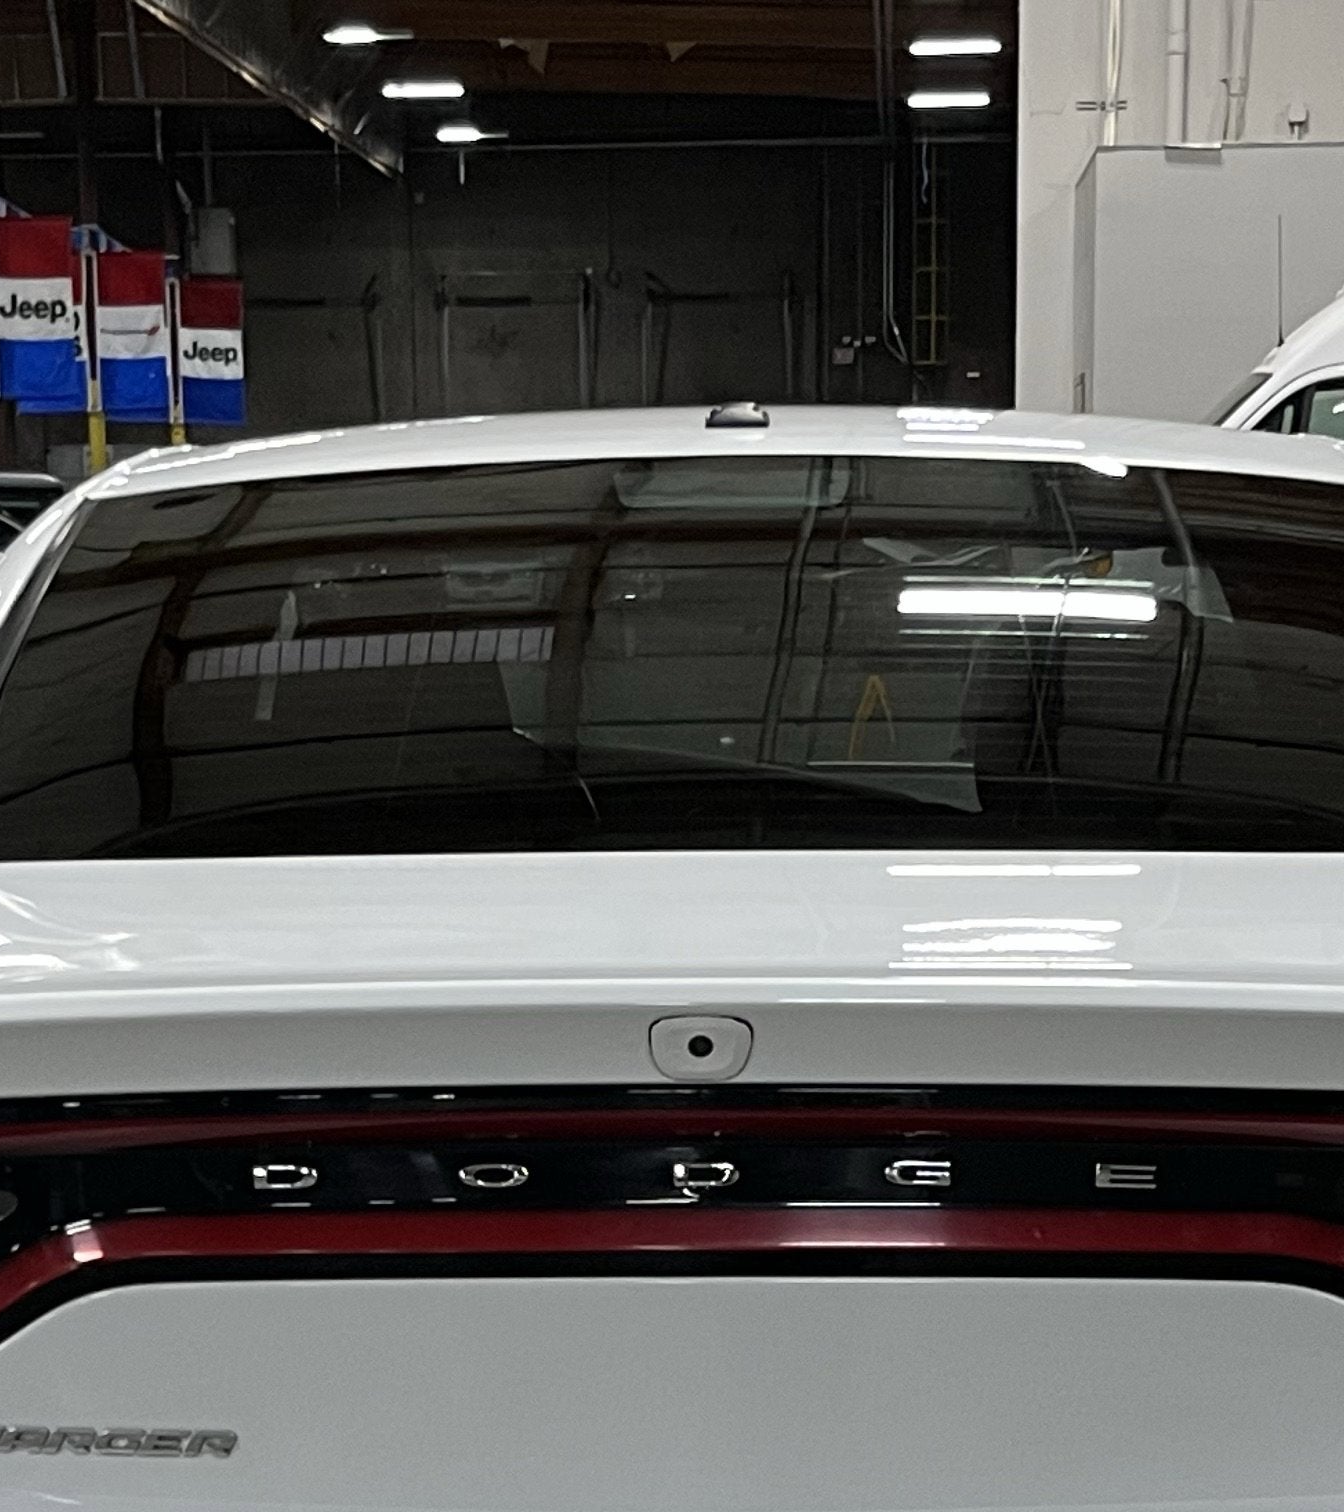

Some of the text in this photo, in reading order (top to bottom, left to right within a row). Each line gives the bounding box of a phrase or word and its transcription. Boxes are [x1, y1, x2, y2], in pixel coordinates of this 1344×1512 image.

[0, 293, 67, 324] Jeep
[182, 341, 238, 366] Jeep
[252, 1160, 1158, 1192] DODGE
